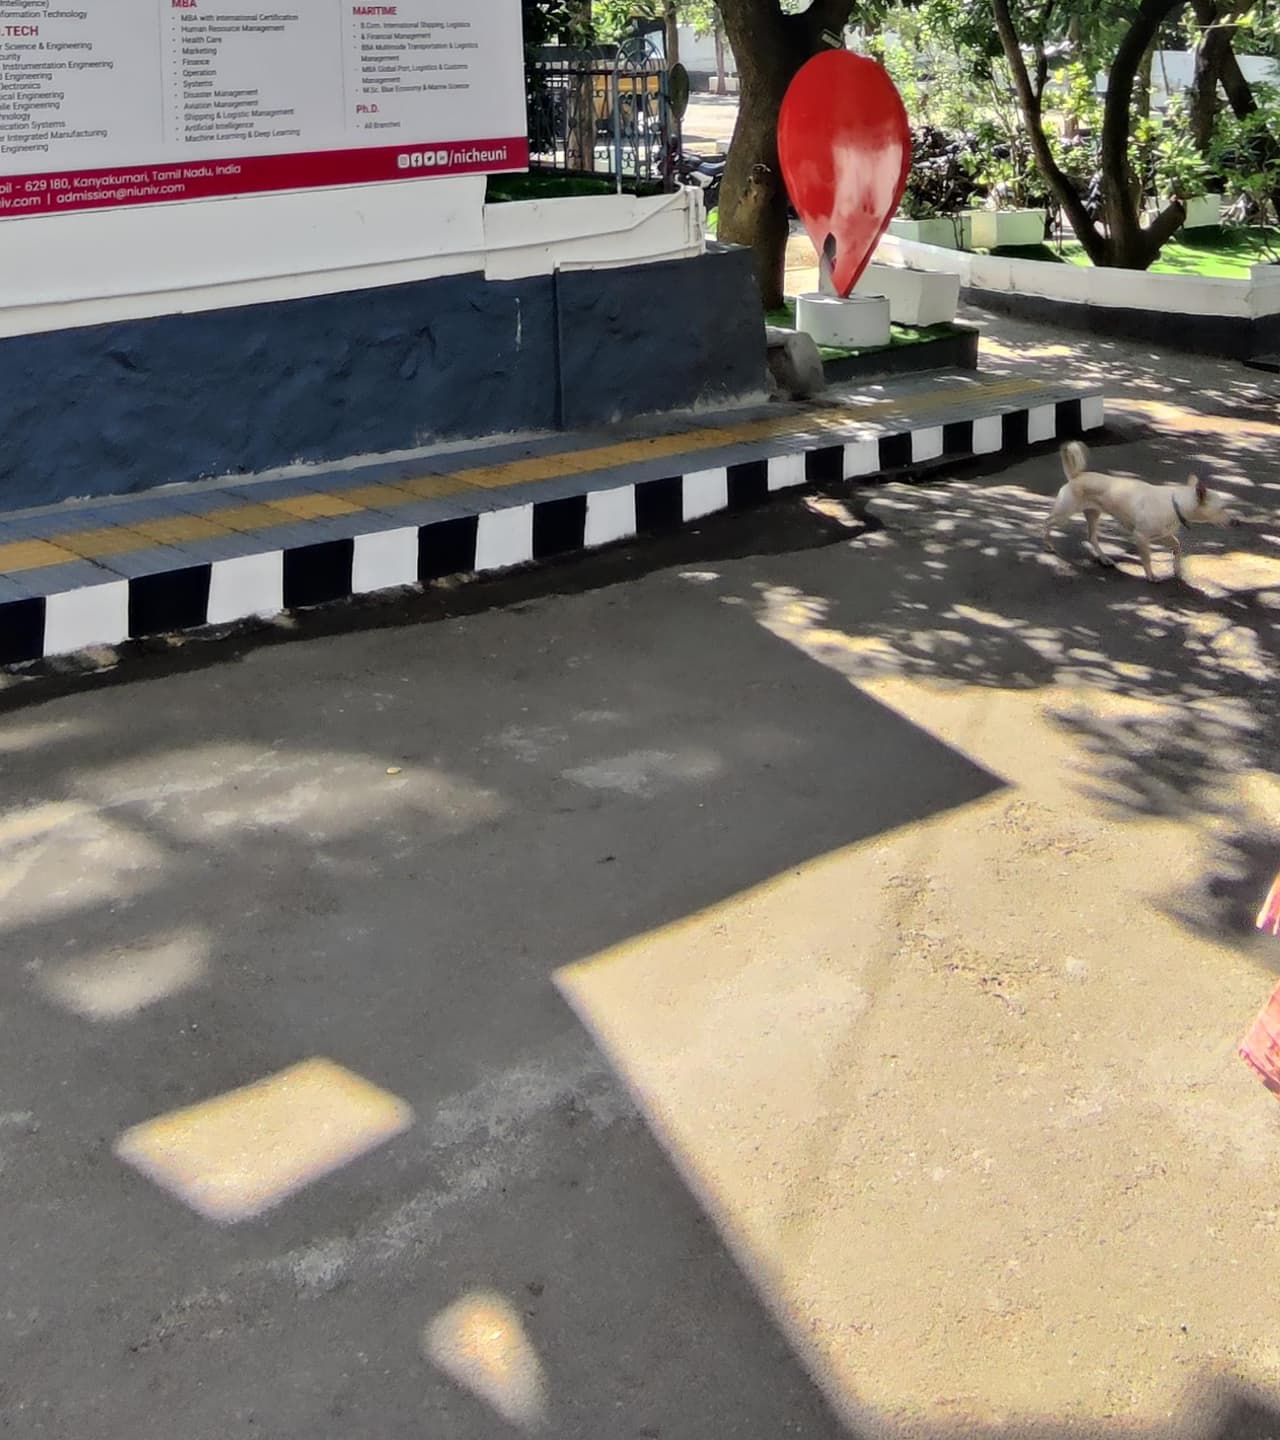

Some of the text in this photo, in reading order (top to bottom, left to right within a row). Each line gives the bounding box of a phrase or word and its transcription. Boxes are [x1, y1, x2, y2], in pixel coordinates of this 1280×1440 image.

[0, 0, 50, 9] Intelligence)
[42, 8, 88, 20] Technology
[352, 6, 397, 16] MARITIME
[3, 62, 67, 70] Instrumentation
[68, 61, 114, 70] Engineering
[5, 72, 53, 82] Engineering
[356, 104, 379, 114] Ph.D.
[31, 121, 66, 131] Systems
[7, 132, 49, 143] Integrated
[50, 129, 108, 139] Manufacturing
[0, 144, 49, 154] Engineering
[447, 145, 507, 167] /nicheuni
[25, 179, 47, 192] 629
[50, 178, 71, 190] 180,
[73, 172, 150, 188] Kanyakumari,
[152, 169, 182, 181] Tamil
[183, 167, 214, 178] Nadu,
[215, 164, 241, 175] India
[56, 184, 185, 204] admission@niuniv.com
